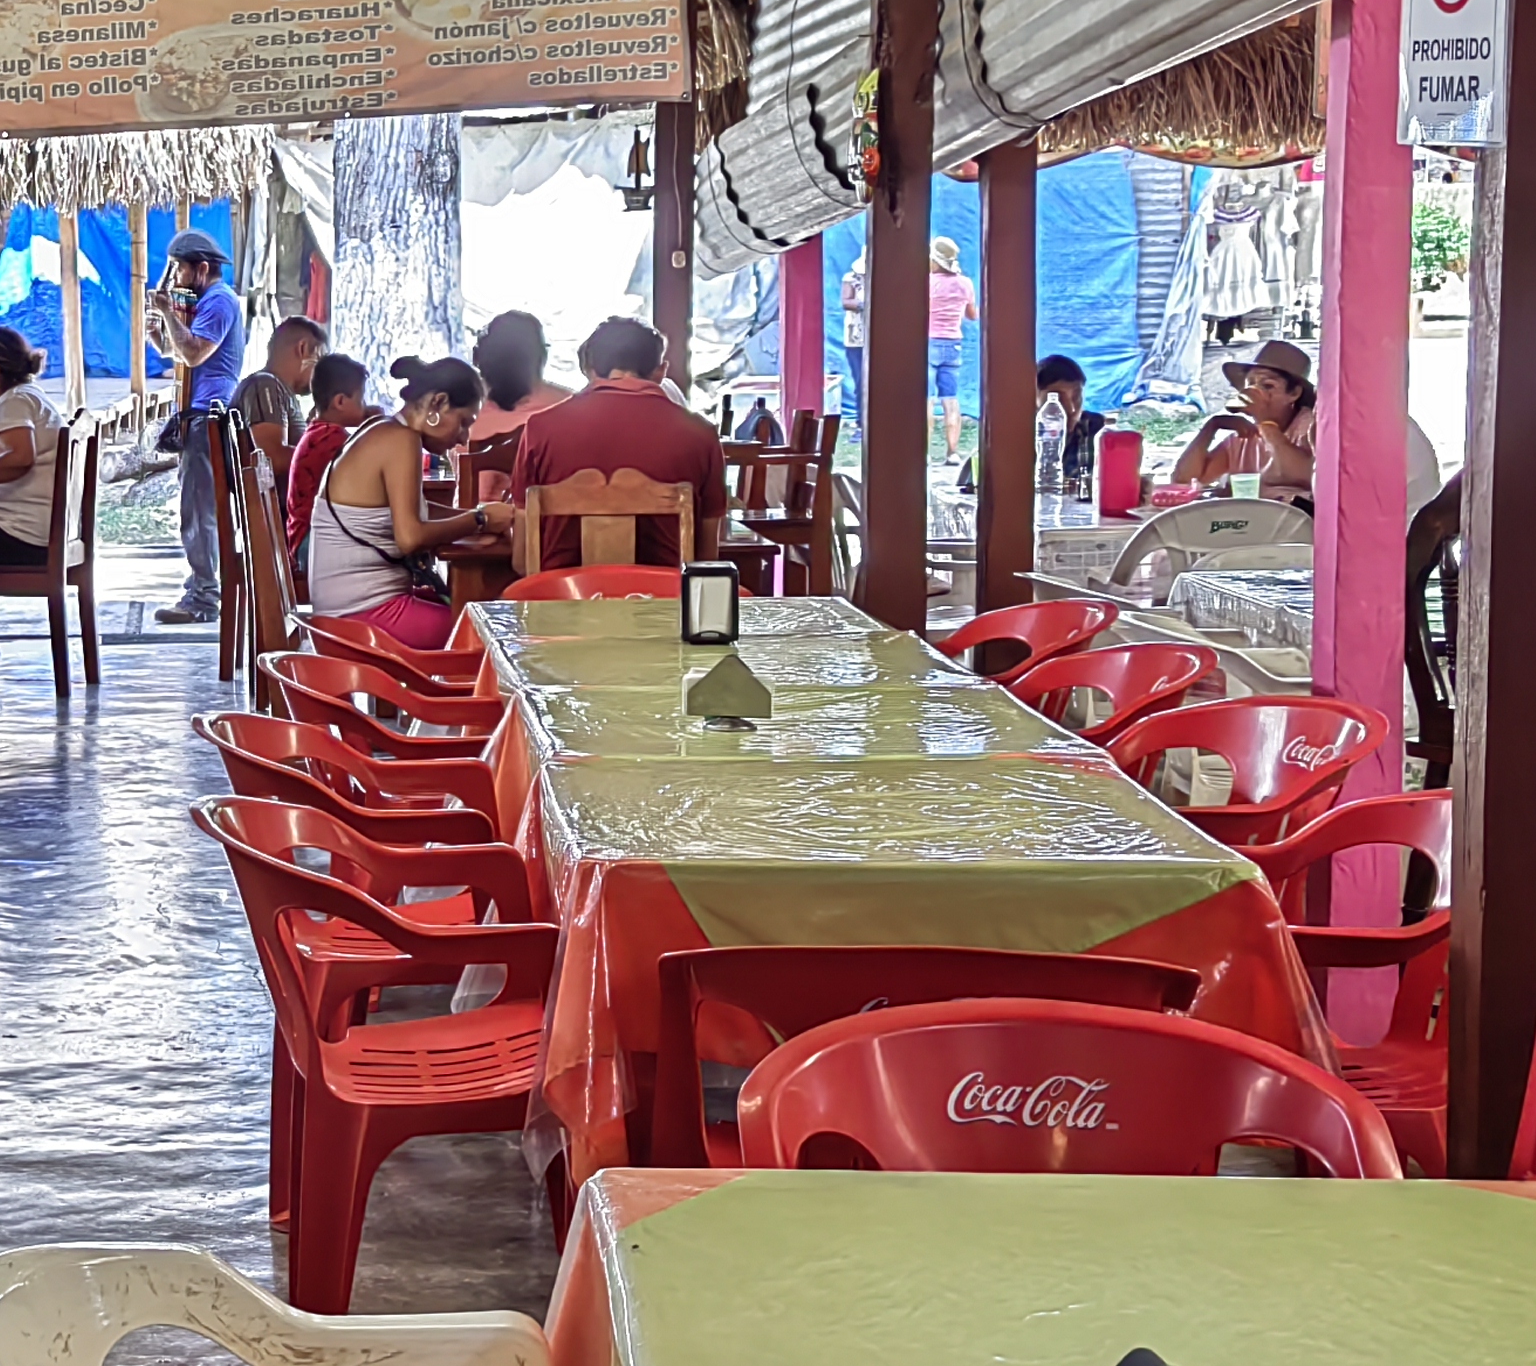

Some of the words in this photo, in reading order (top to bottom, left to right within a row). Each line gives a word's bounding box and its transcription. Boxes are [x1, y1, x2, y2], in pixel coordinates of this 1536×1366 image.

[1412, 36, 1491, 62] PROHIBIDO
[1418, 75, 1480, 103] FUMAR
[947, 1071, 1110, 1130] Coca-Cola
